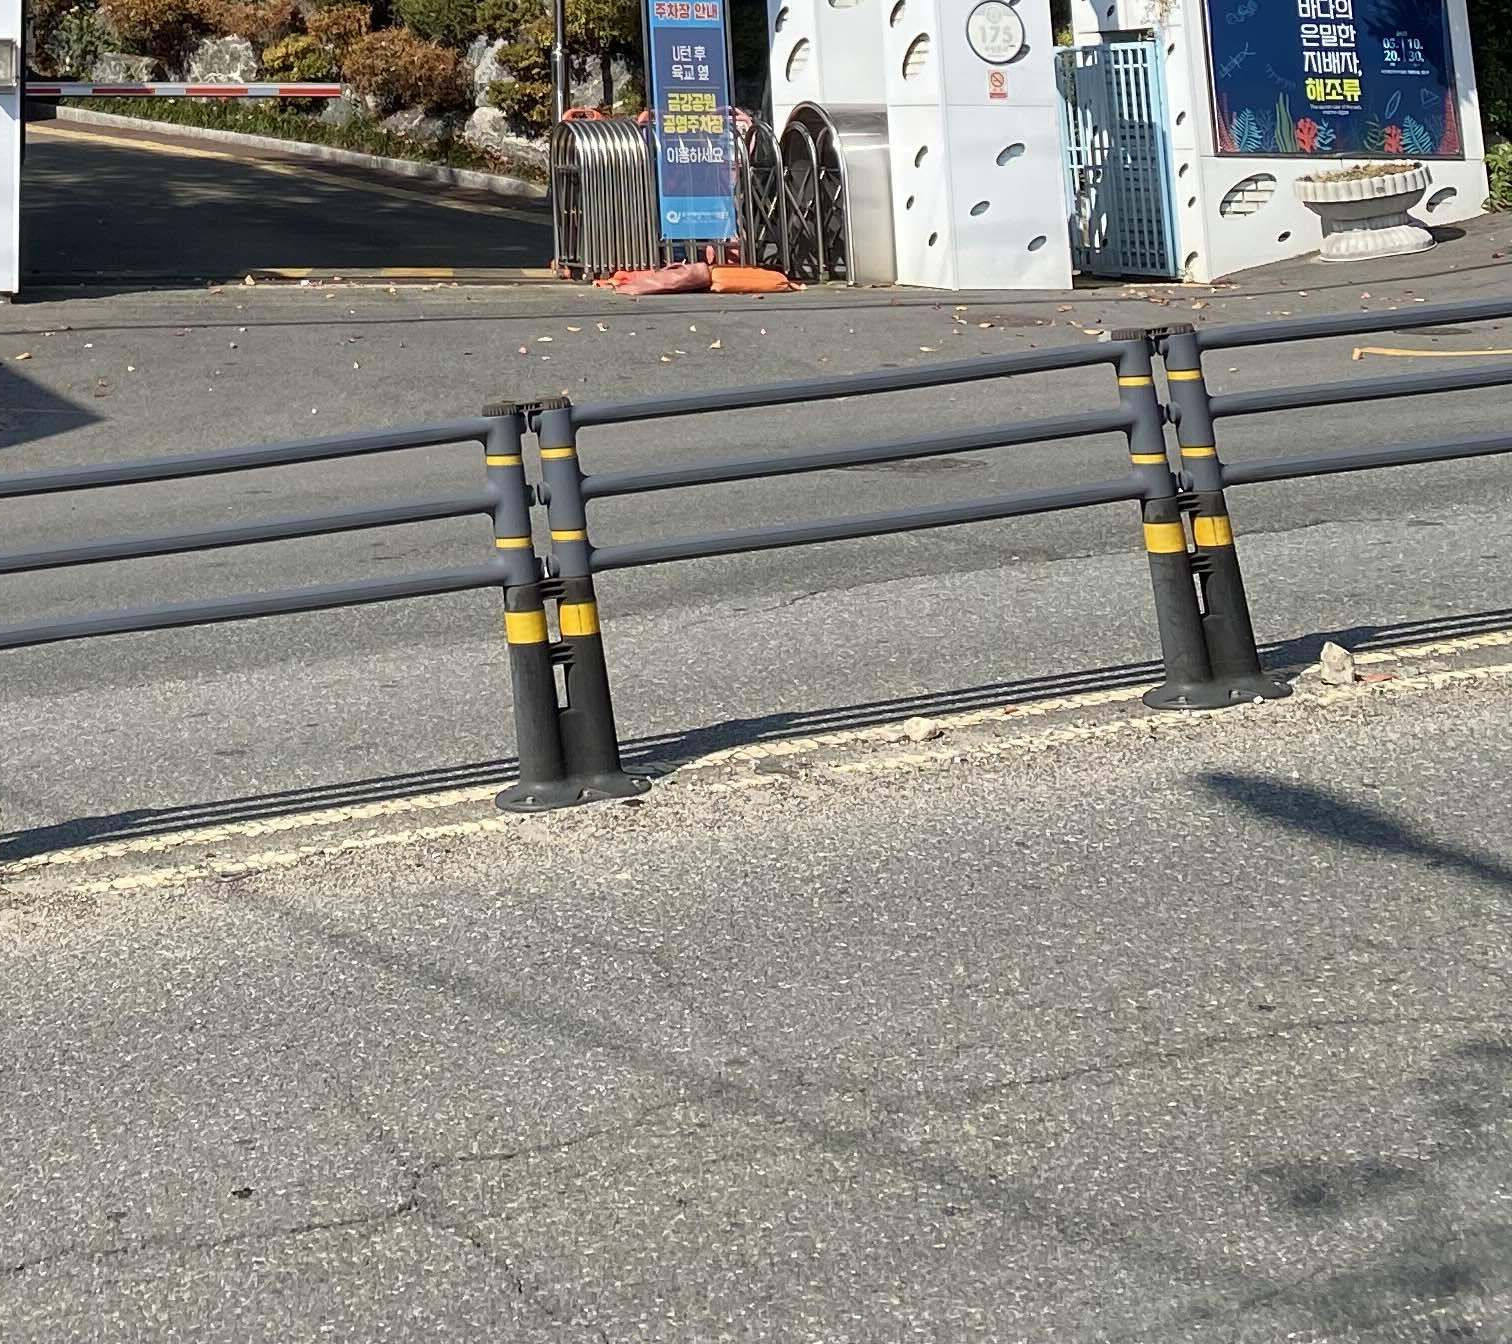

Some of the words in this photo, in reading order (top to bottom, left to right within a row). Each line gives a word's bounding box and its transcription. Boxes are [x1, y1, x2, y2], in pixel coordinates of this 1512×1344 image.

[655, 2, 690, 20] 주차장
[694, 2, 718, 20] 안내
[1300, 23, 1356, 47] 은밀한
[672, 45, 692, 61] U턴
[693, 45, 706, 61] 후
[1303, 51, 1362, 76] 지배자,
[1305, 77, 1361, 101] 해조류
[668, 93, 717, 112] 금강공원
[663, 114, 723, 133] 공영주차장
[666, 146, 724, 164] 이용하세요
